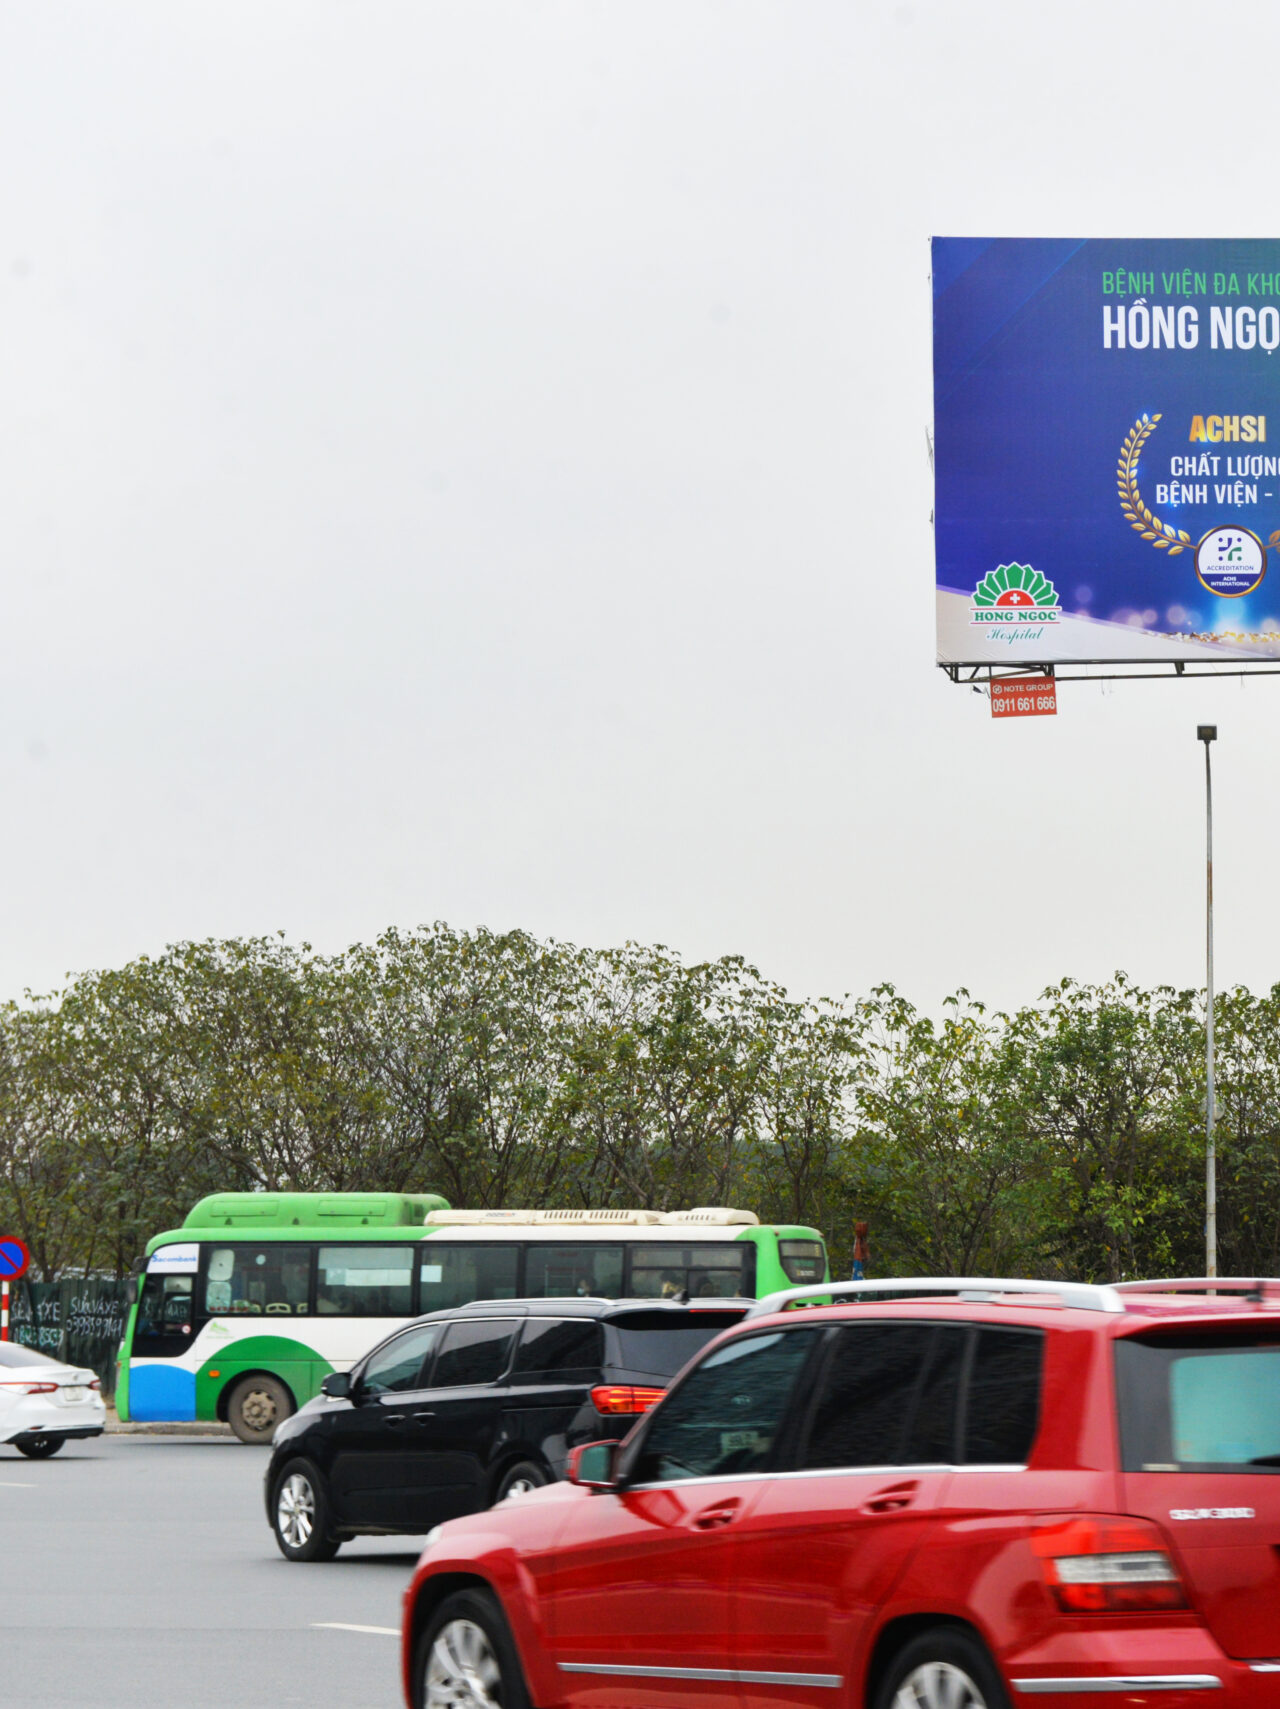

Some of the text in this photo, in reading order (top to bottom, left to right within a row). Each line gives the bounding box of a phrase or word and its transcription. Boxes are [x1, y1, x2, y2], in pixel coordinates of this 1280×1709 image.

[1103, 268, 1155, 299] BỆNH
[1162, 268, 1207, 298] VIỆN
[1213, 272, 1241, 296] ĐA
[1103, 297, 1199, 350] HỒNG
[1189, 414, 1266, 443] ACHSI
[1170, 451, 1221, 477] CHẤT
[1156, 480, 1208, 507] BỆNH
[1214, 480, 1259, 506] VIỆN
[974, 611, 1057, 621] HONG NGOC
[986, 626, 1045, 645] Hospital
[1003, 683, 1054, 693] NOTE GROUP
[992, 696, 1056, 713] 0911 661 666
